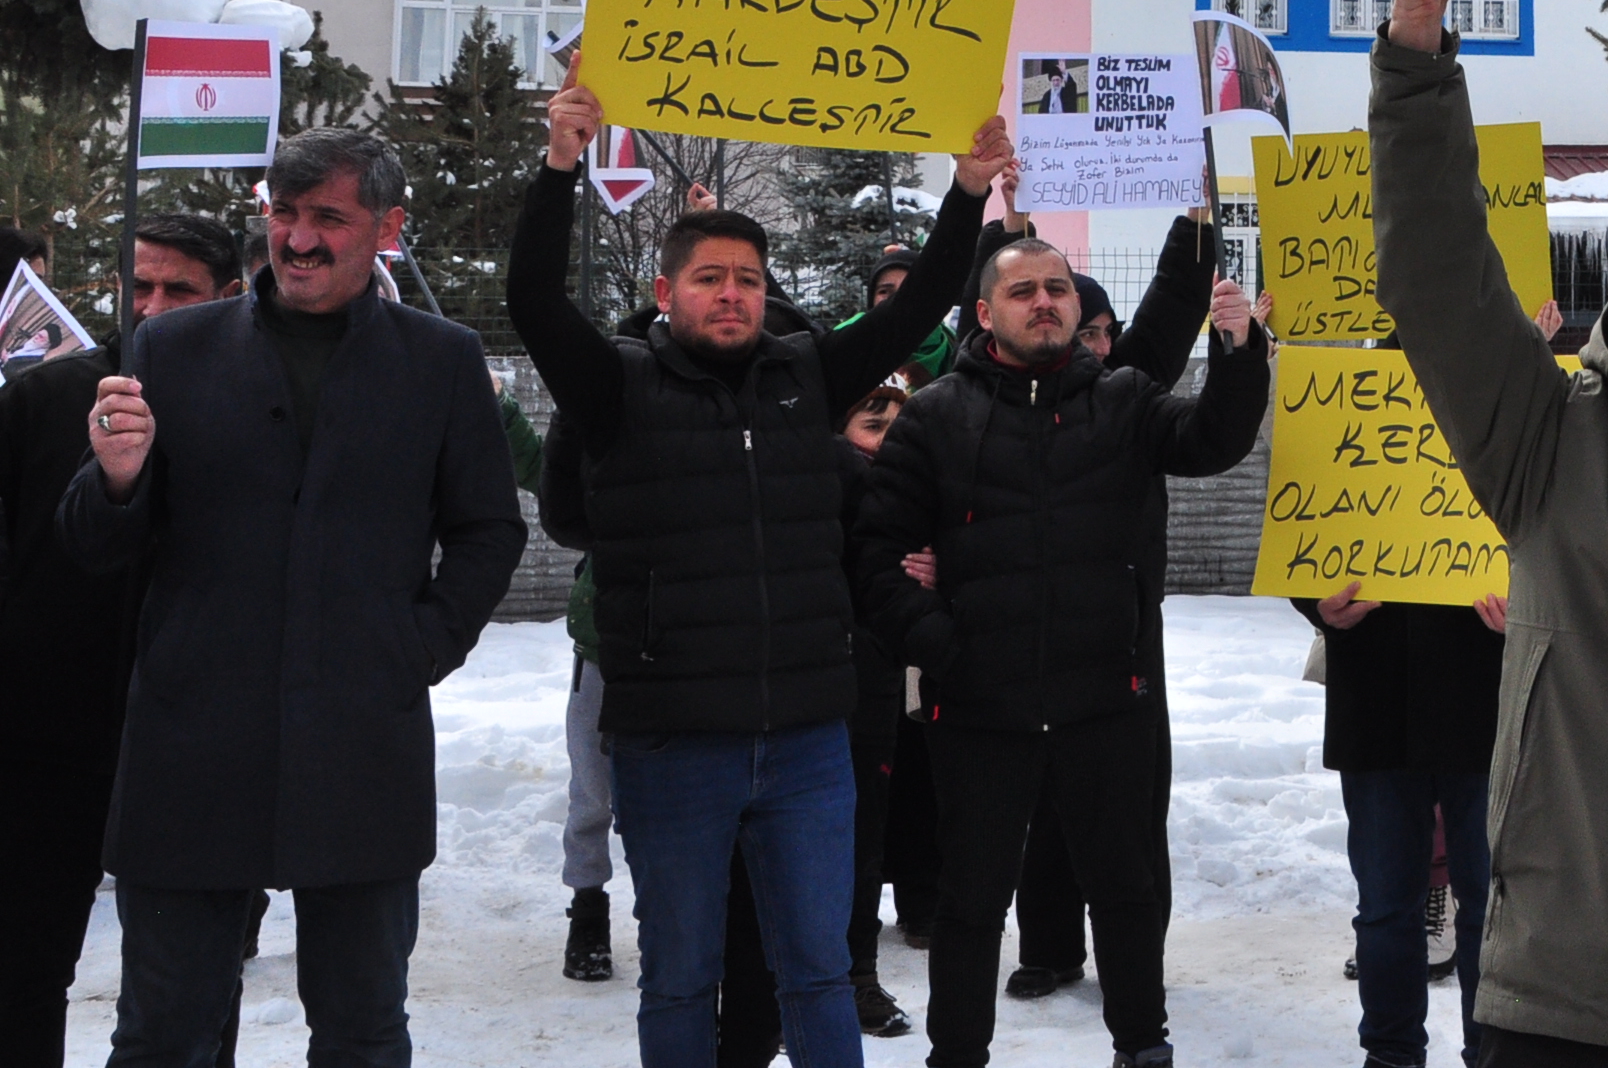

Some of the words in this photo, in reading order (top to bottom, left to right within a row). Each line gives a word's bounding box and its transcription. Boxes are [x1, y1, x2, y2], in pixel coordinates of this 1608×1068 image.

[617, 19, 780, 67] İSRAİL
[811, 44, 910, 84] ABD
[1097, 55, 1120, 72] BİZ
[1125, 56, 1171, 72] TESLİM
[1096, 74, 1149, 94] OLMAYI
[1096, 92, 1175, 112] KERBELADA
[1094, 113, 1167, 132] UNUTTUK
[1020, 136, 1051, 152] Bizim
[1019, 156, 1033, 173] Ya
[1032, 180, 1089, 206] SEYYİD
[1091, 180, 1119, 205] ALİ
[1122, 179, 1202, 203] HAMANEY
[1270, 481, 1402, 522] OLANI
